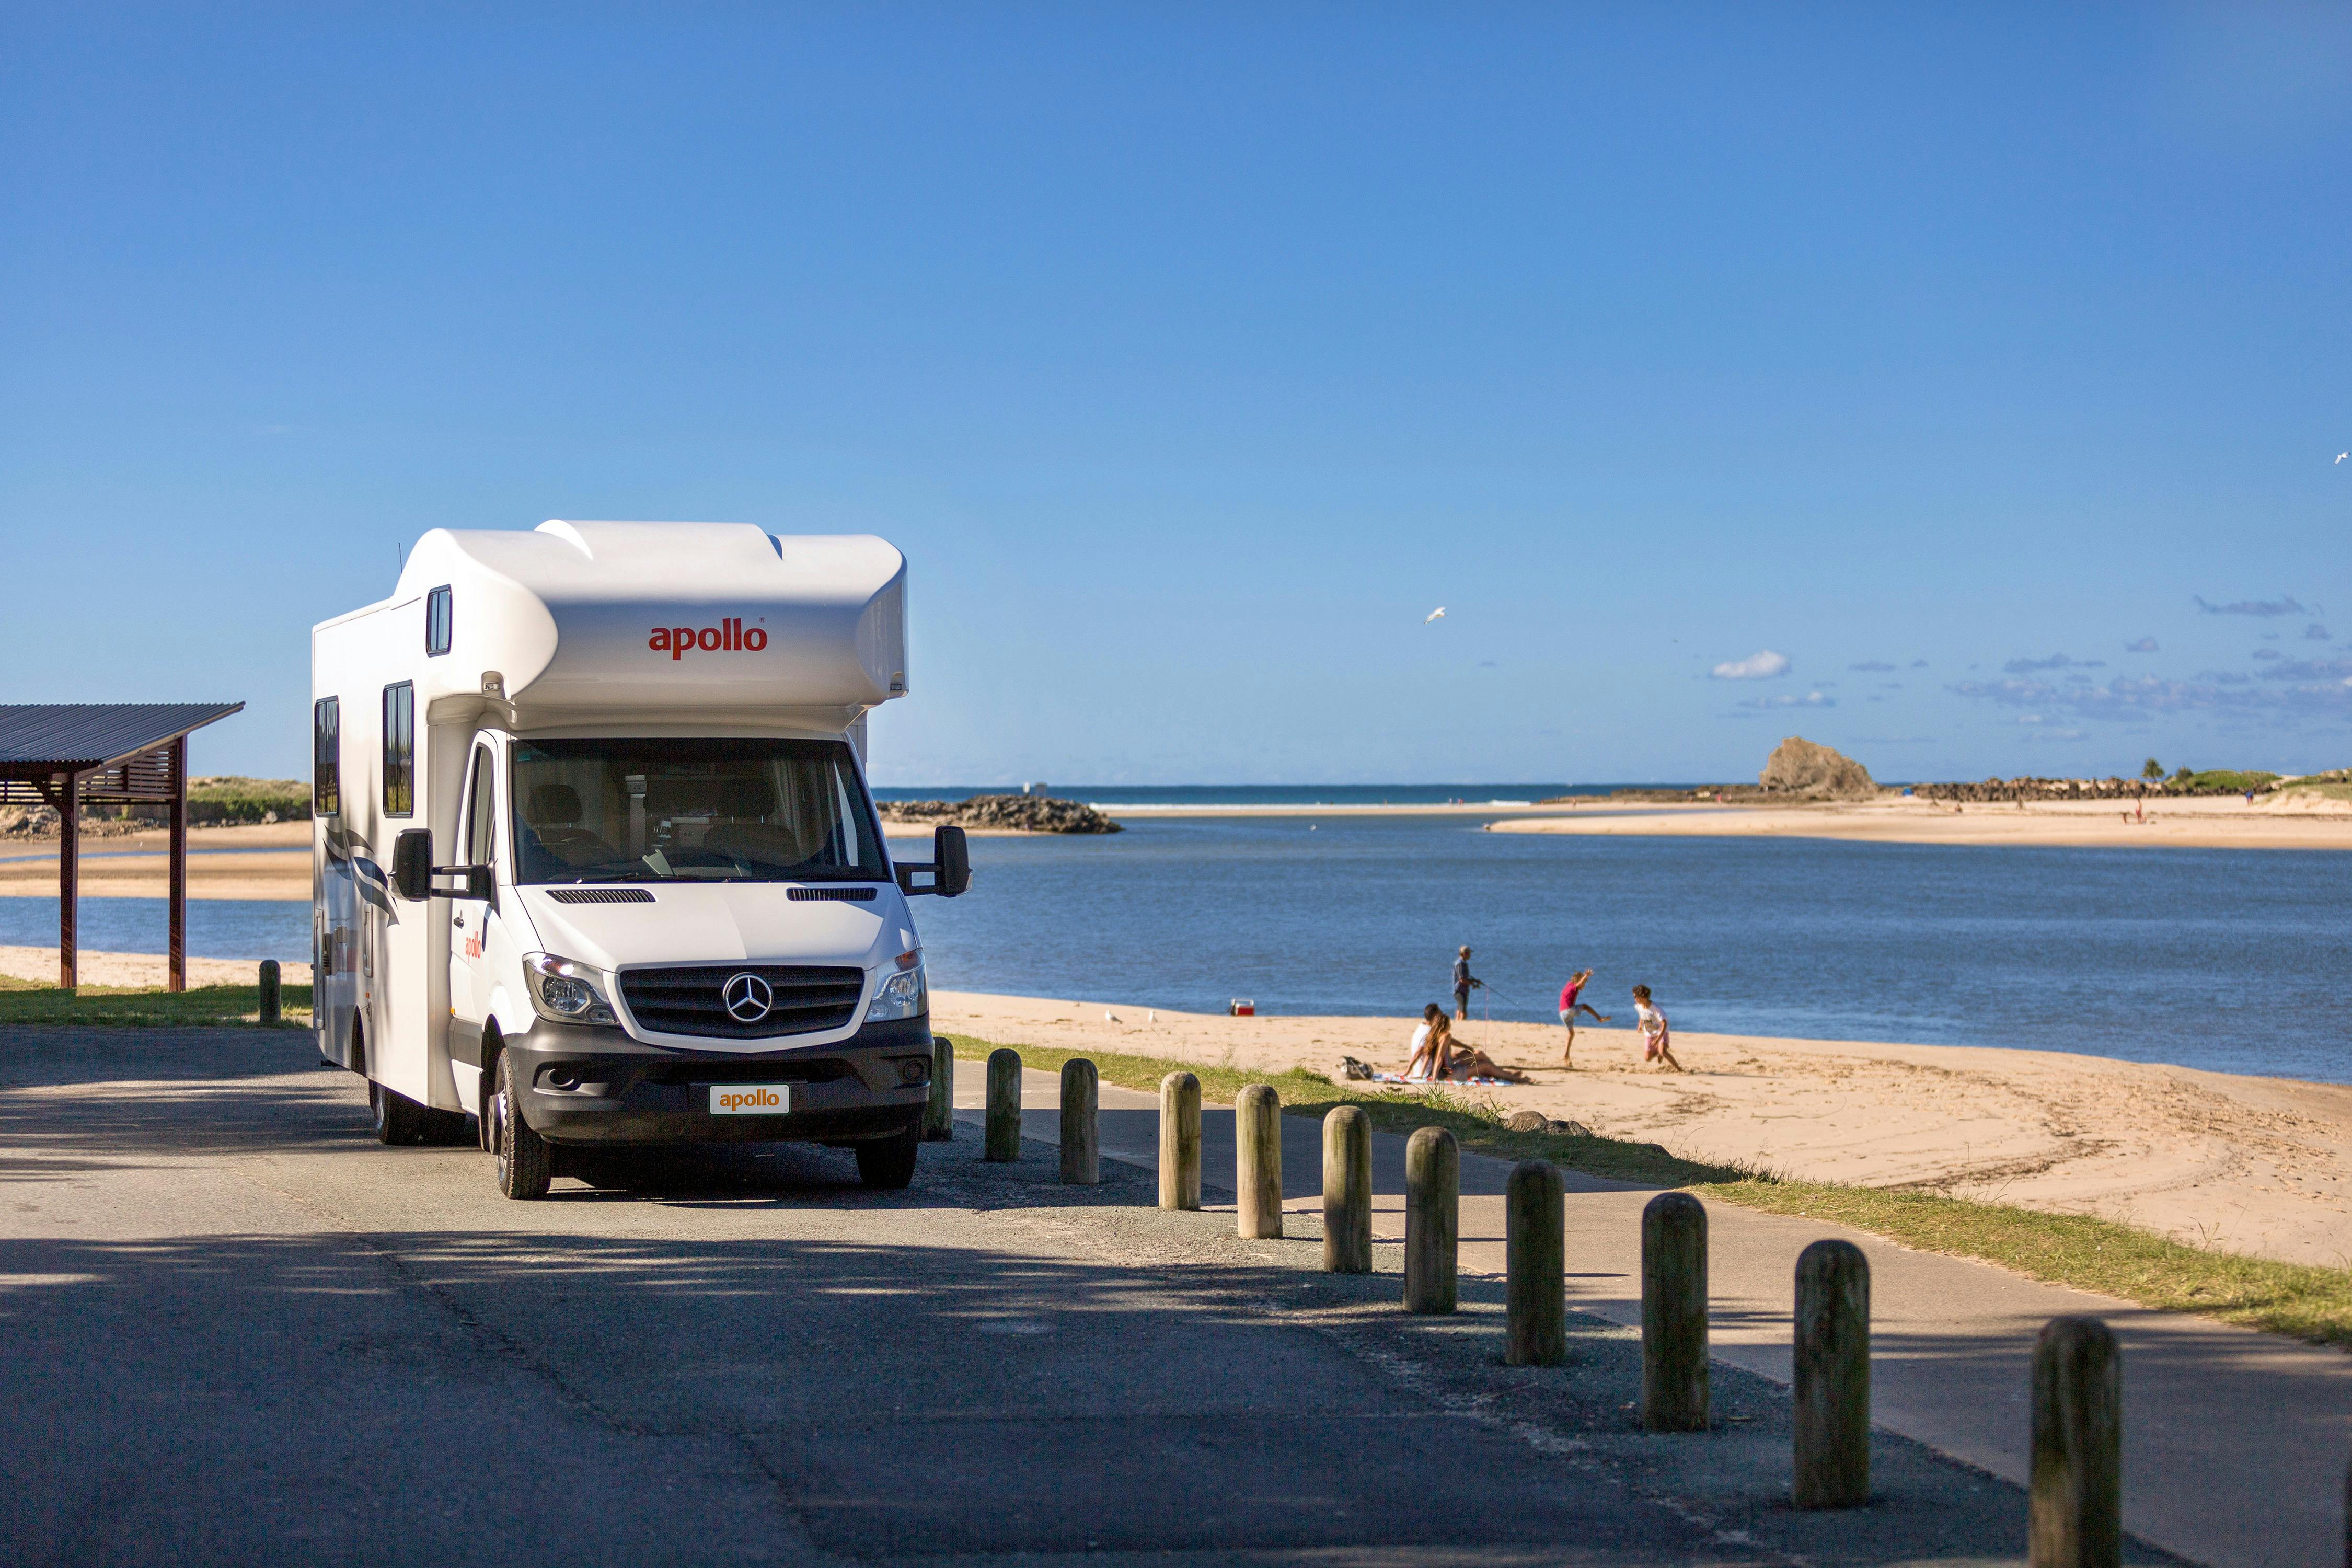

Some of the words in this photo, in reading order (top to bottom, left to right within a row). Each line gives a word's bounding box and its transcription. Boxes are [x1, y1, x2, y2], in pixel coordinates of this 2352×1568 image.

[649, 618, 767, 660] apollo
[466, 931, 481, 963] apollo
[720, 1089, 779, 1111] apollo
